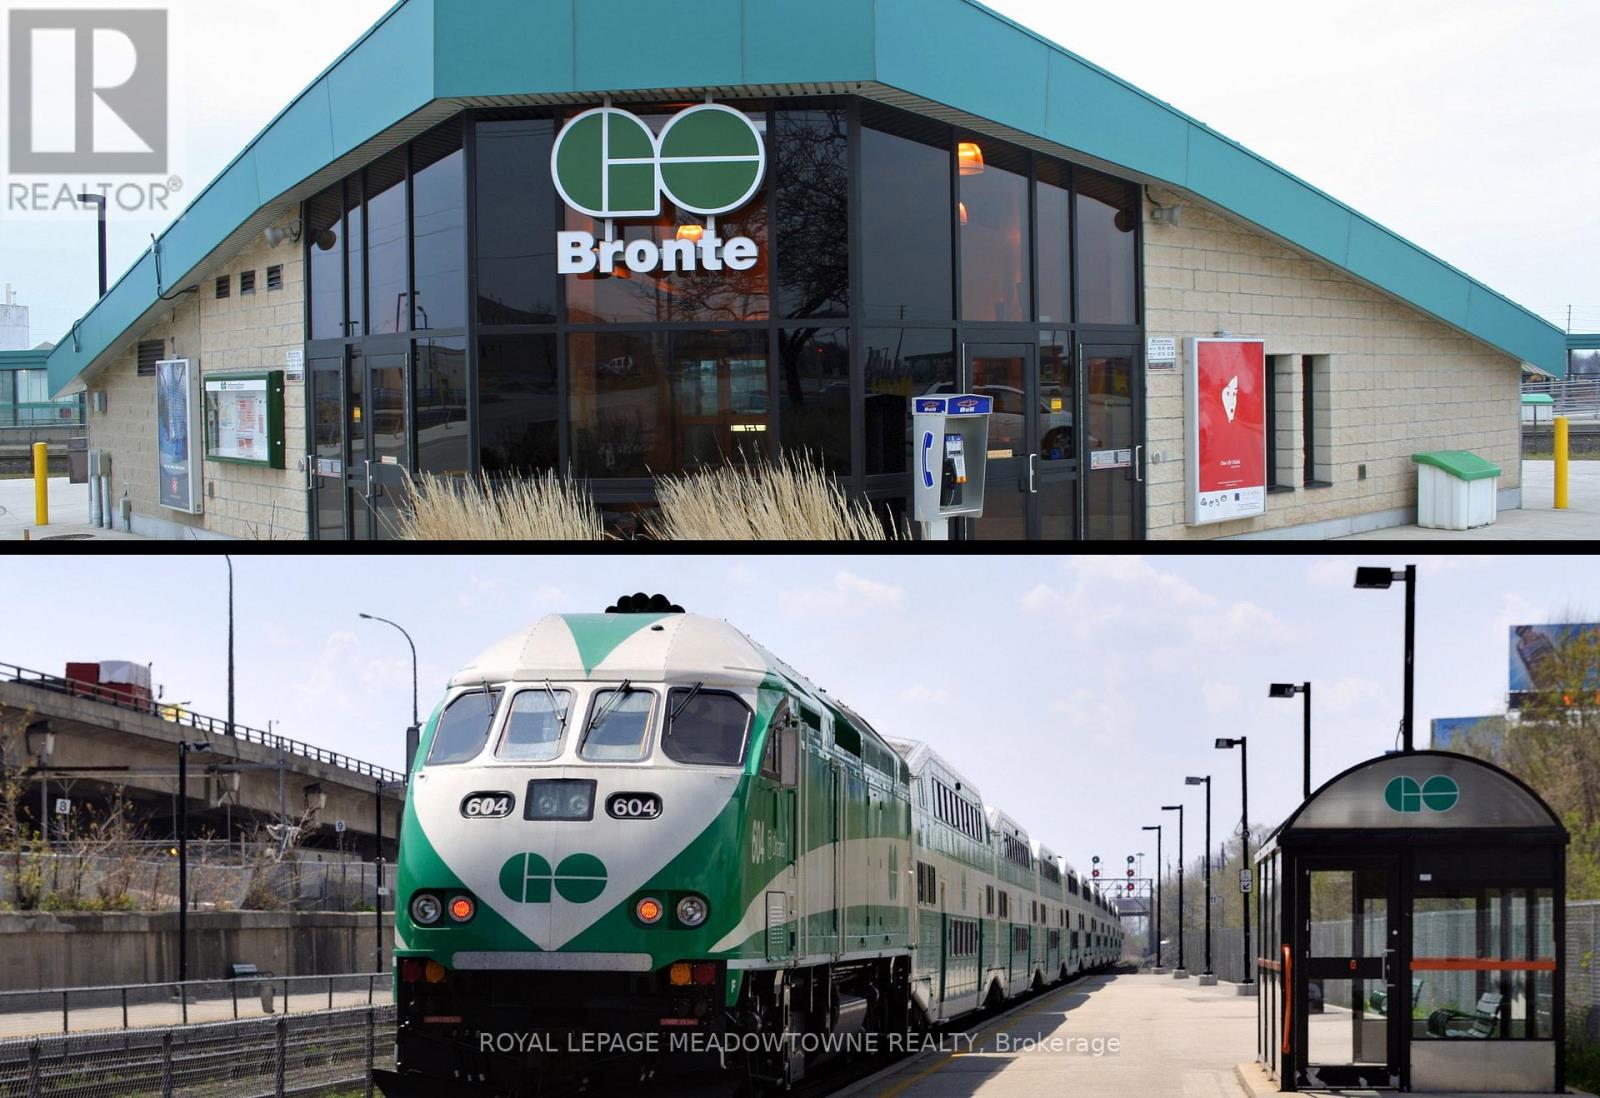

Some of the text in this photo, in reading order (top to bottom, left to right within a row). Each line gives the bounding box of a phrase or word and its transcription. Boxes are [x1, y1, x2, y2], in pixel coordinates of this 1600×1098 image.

[557, 228, 759, 275] Bronte
[59, 800, 67, 811] 8
[466, 797, 508, 815] 604
[613, 798, 657, 816] 604
[752, 819, 765, 864] 604
